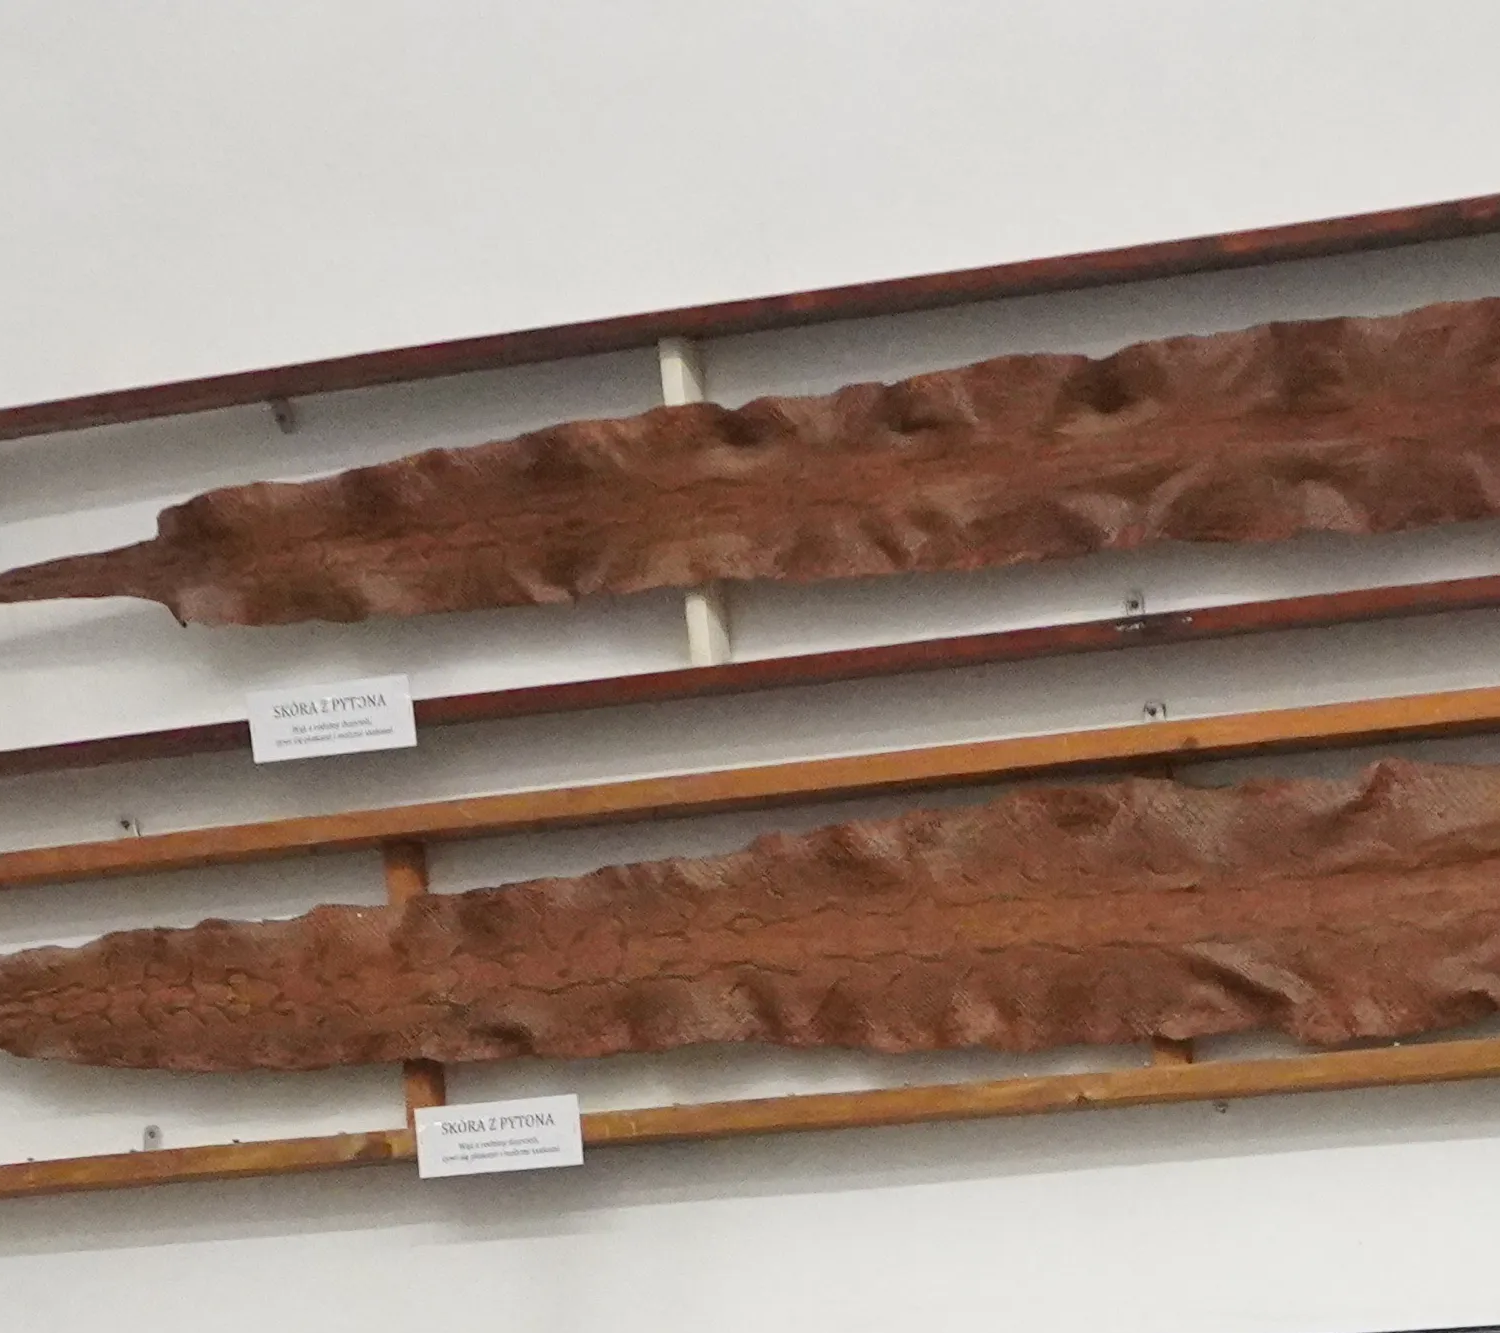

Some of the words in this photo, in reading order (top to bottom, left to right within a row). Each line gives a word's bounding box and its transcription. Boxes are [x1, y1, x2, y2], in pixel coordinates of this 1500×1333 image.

[273, 700, 318, 719] SKÓRA
[332, 694, 387, 711] PYTONA
[441, 1117, 486, 1135] SKÓRA
[488, 1117, 497, 1131] Z
[500, 1113, 556, 1130] PYTONA
